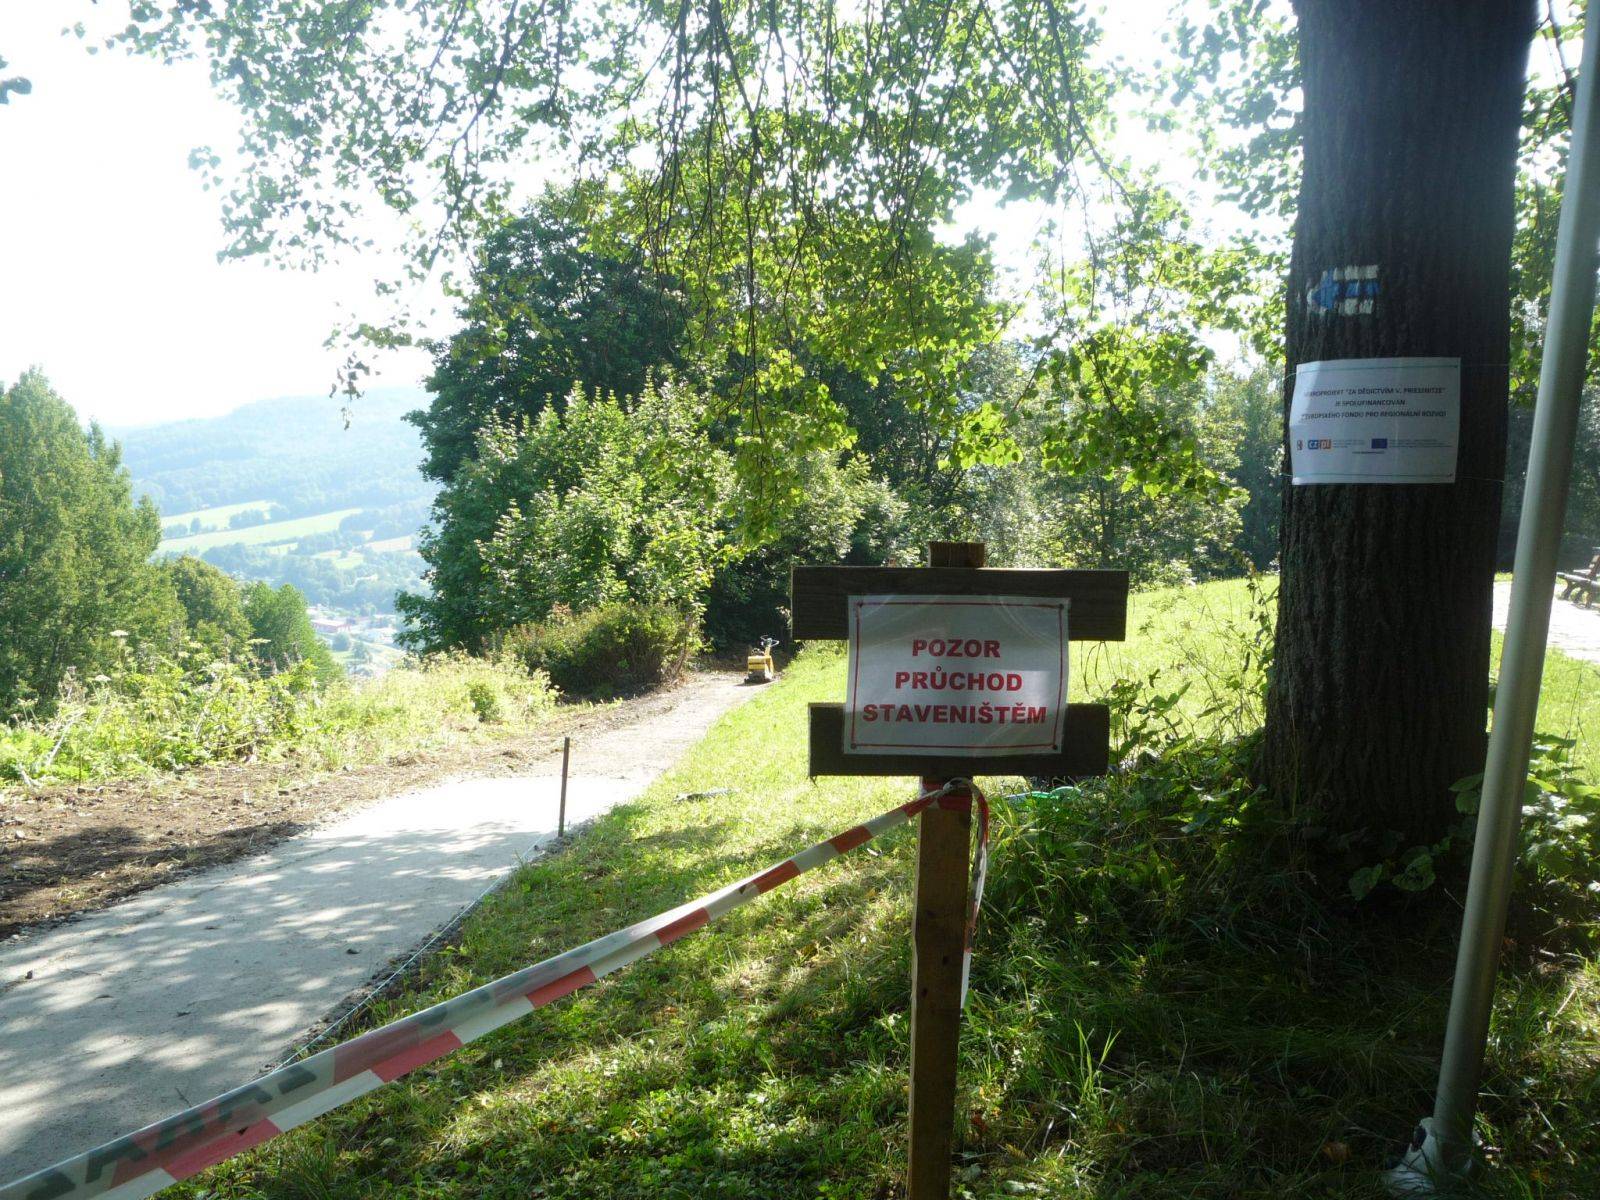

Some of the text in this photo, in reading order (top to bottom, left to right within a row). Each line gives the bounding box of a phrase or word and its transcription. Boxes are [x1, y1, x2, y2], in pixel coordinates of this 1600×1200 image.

[912, 639, 1000, 657] POZOR
[895, 666, 1023, 691] PRŮCHOD
[862, 702, 1047, 724] STAVENIŠTĚM
